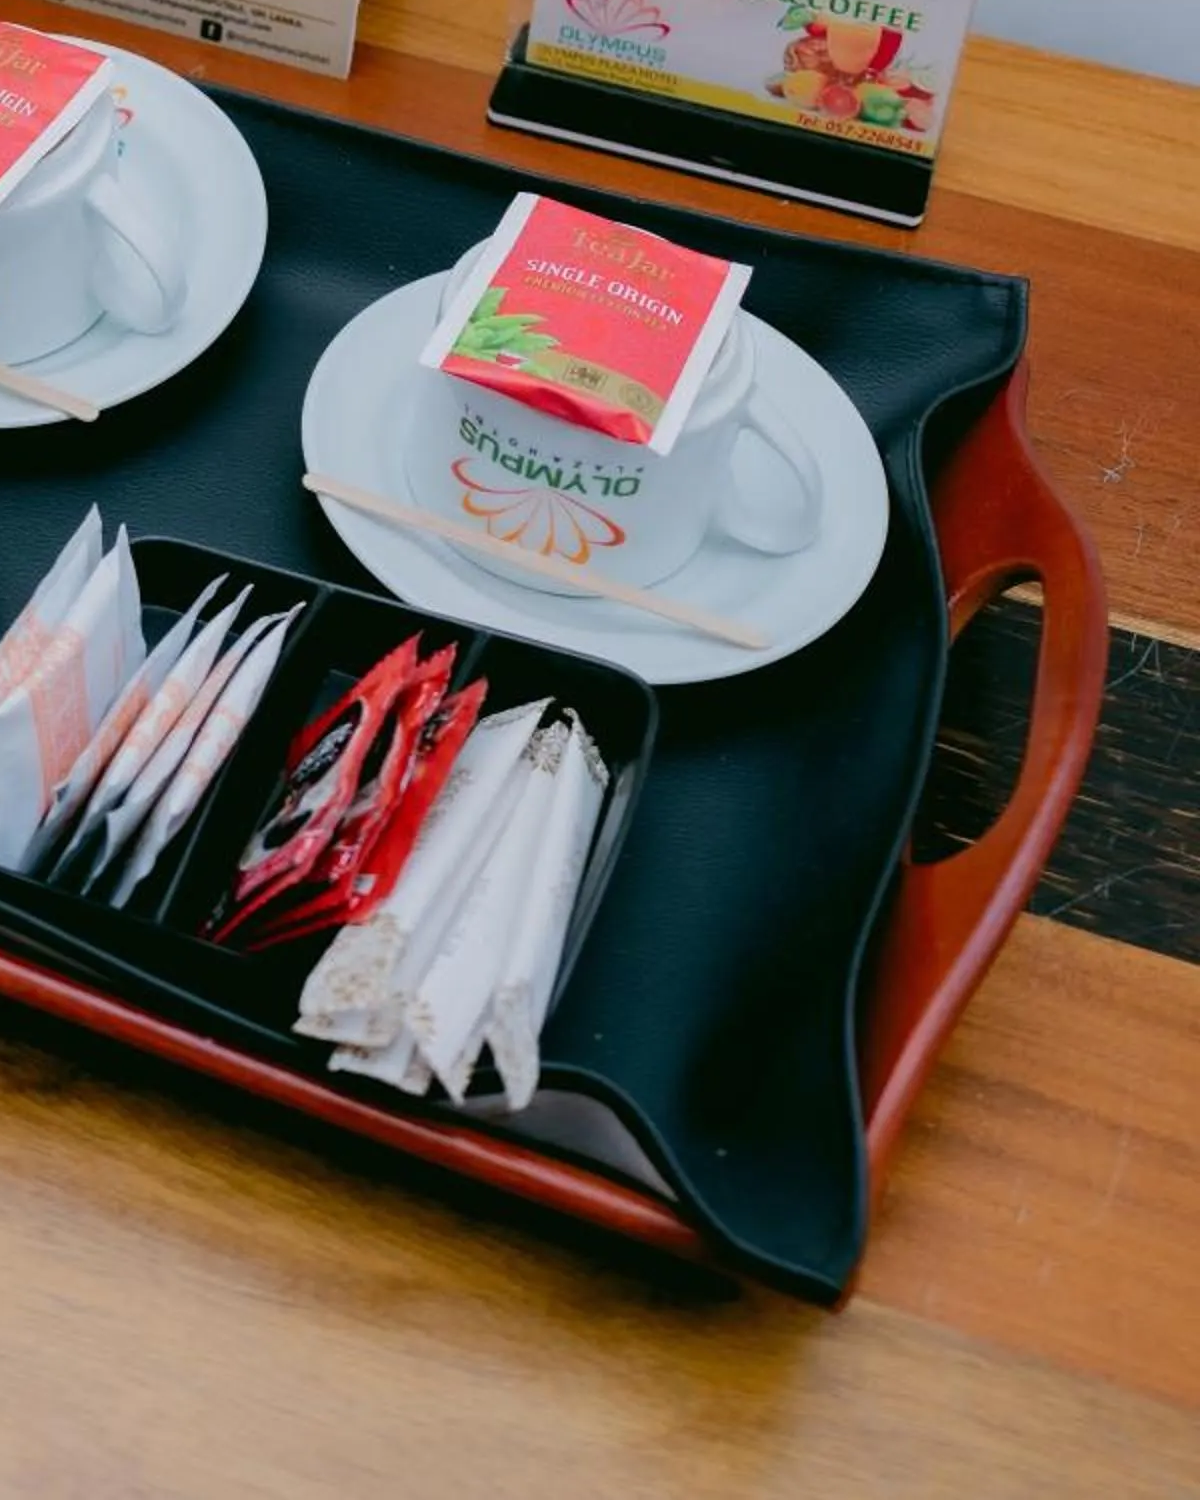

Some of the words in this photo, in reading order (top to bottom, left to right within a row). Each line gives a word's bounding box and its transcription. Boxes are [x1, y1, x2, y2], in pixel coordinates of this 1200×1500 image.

[559, 24, 668, 65] OLYMPUS
[525, 258, 606, 291] SINGLE
[606, 281, 685, 327] ORIGIN
[458, 416, 642, 498] OLYMPUS
